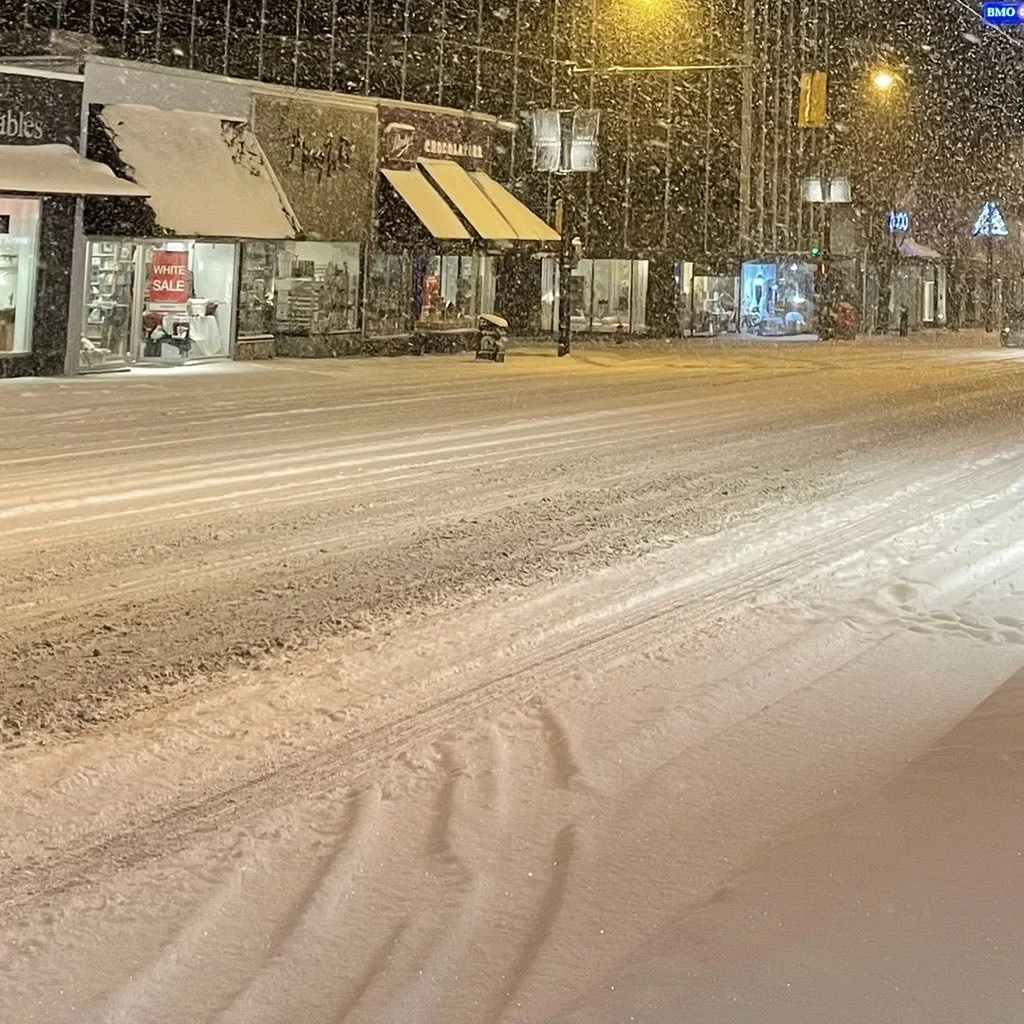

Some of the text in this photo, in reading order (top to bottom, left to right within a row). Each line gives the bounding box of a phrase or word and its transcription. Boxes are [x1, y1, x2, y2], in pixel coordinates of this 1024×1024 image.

[987, 7, 1016, 17] BMO
[153, 264, 186, 275] WHITE
[152, 279, 185, 292] SALE
